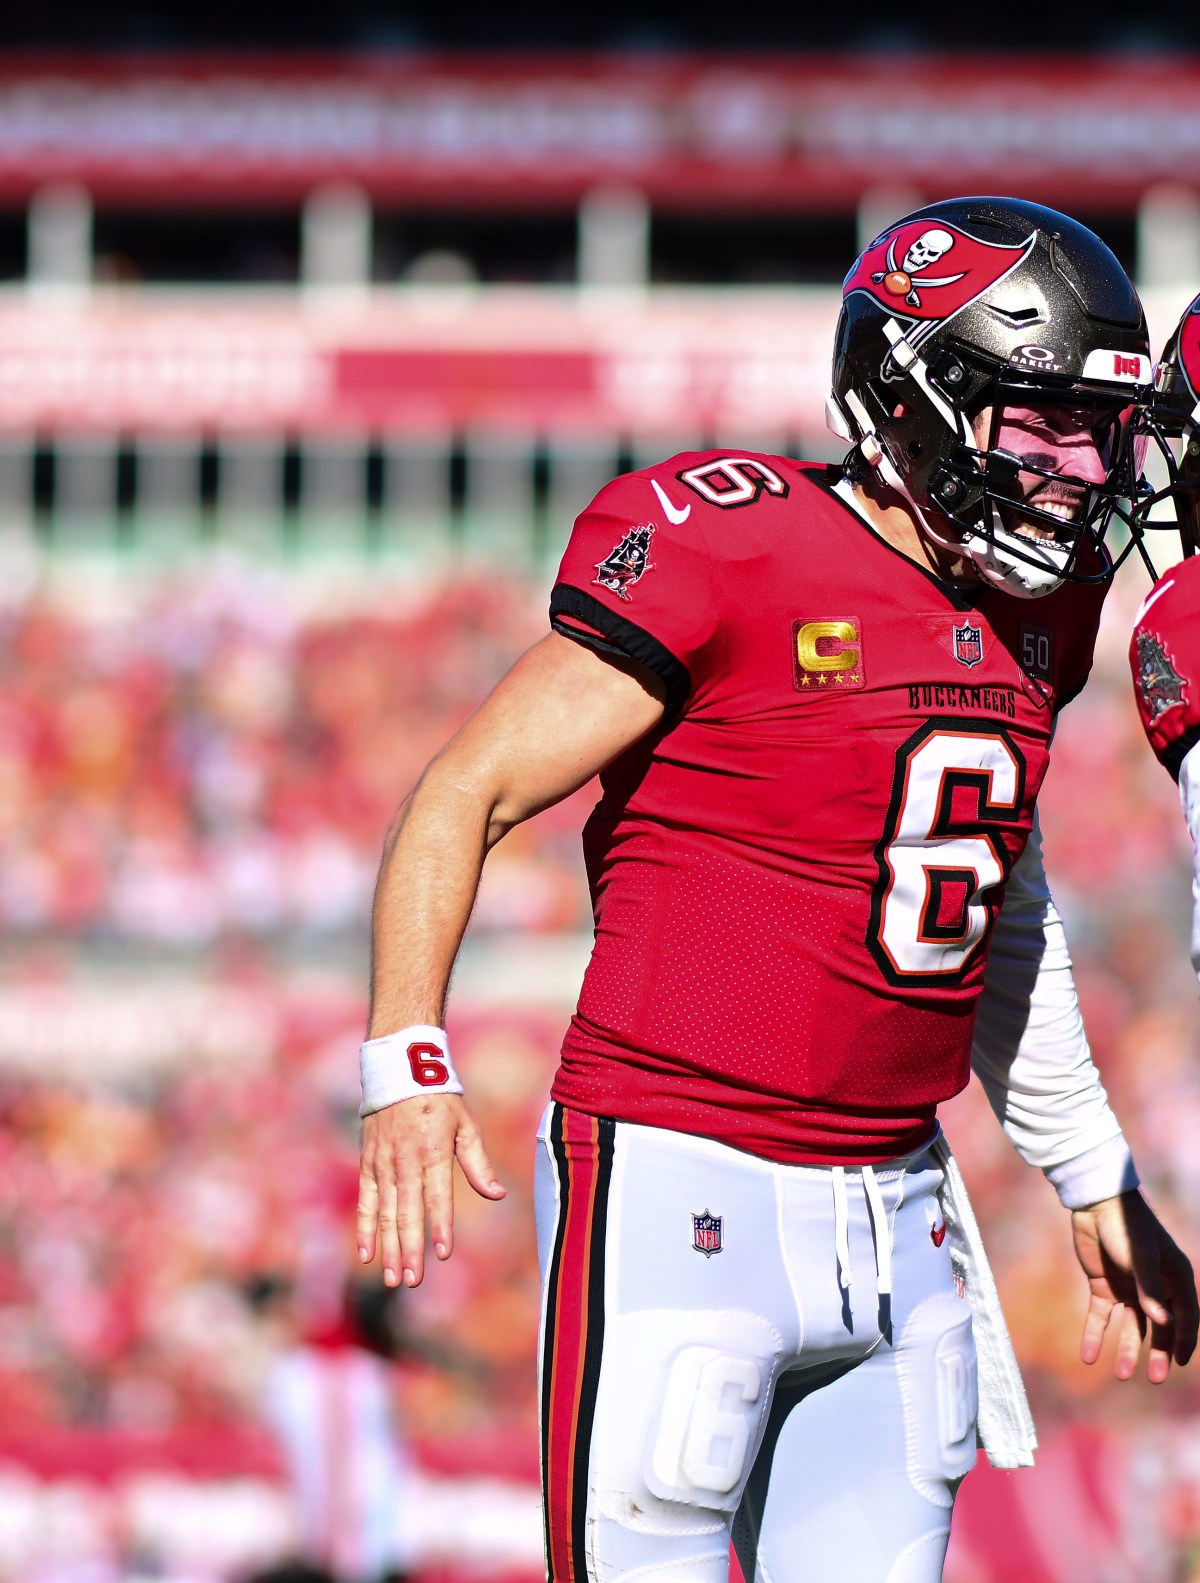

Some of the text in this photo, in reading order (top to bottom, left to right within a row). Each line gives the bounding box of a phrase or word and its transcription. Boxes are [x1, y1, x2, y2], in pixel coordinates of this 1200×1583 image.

[1010, 355, 1063, 371] OAKLEY
[674, 456, 790, 510] 6
[797, 621, 859, 672] C
[958, 642, 980, 660] NFL
[1022, 632, 1049, 670] 50
[908, 686, 1016, 719] BUCCANEERS
[865, 717, 1026, 987] 6
[406, 1042, 450, 1087] 6
[696, 1230, 719, 1249] NFL
[680, 1355, 761, 1494] 6
